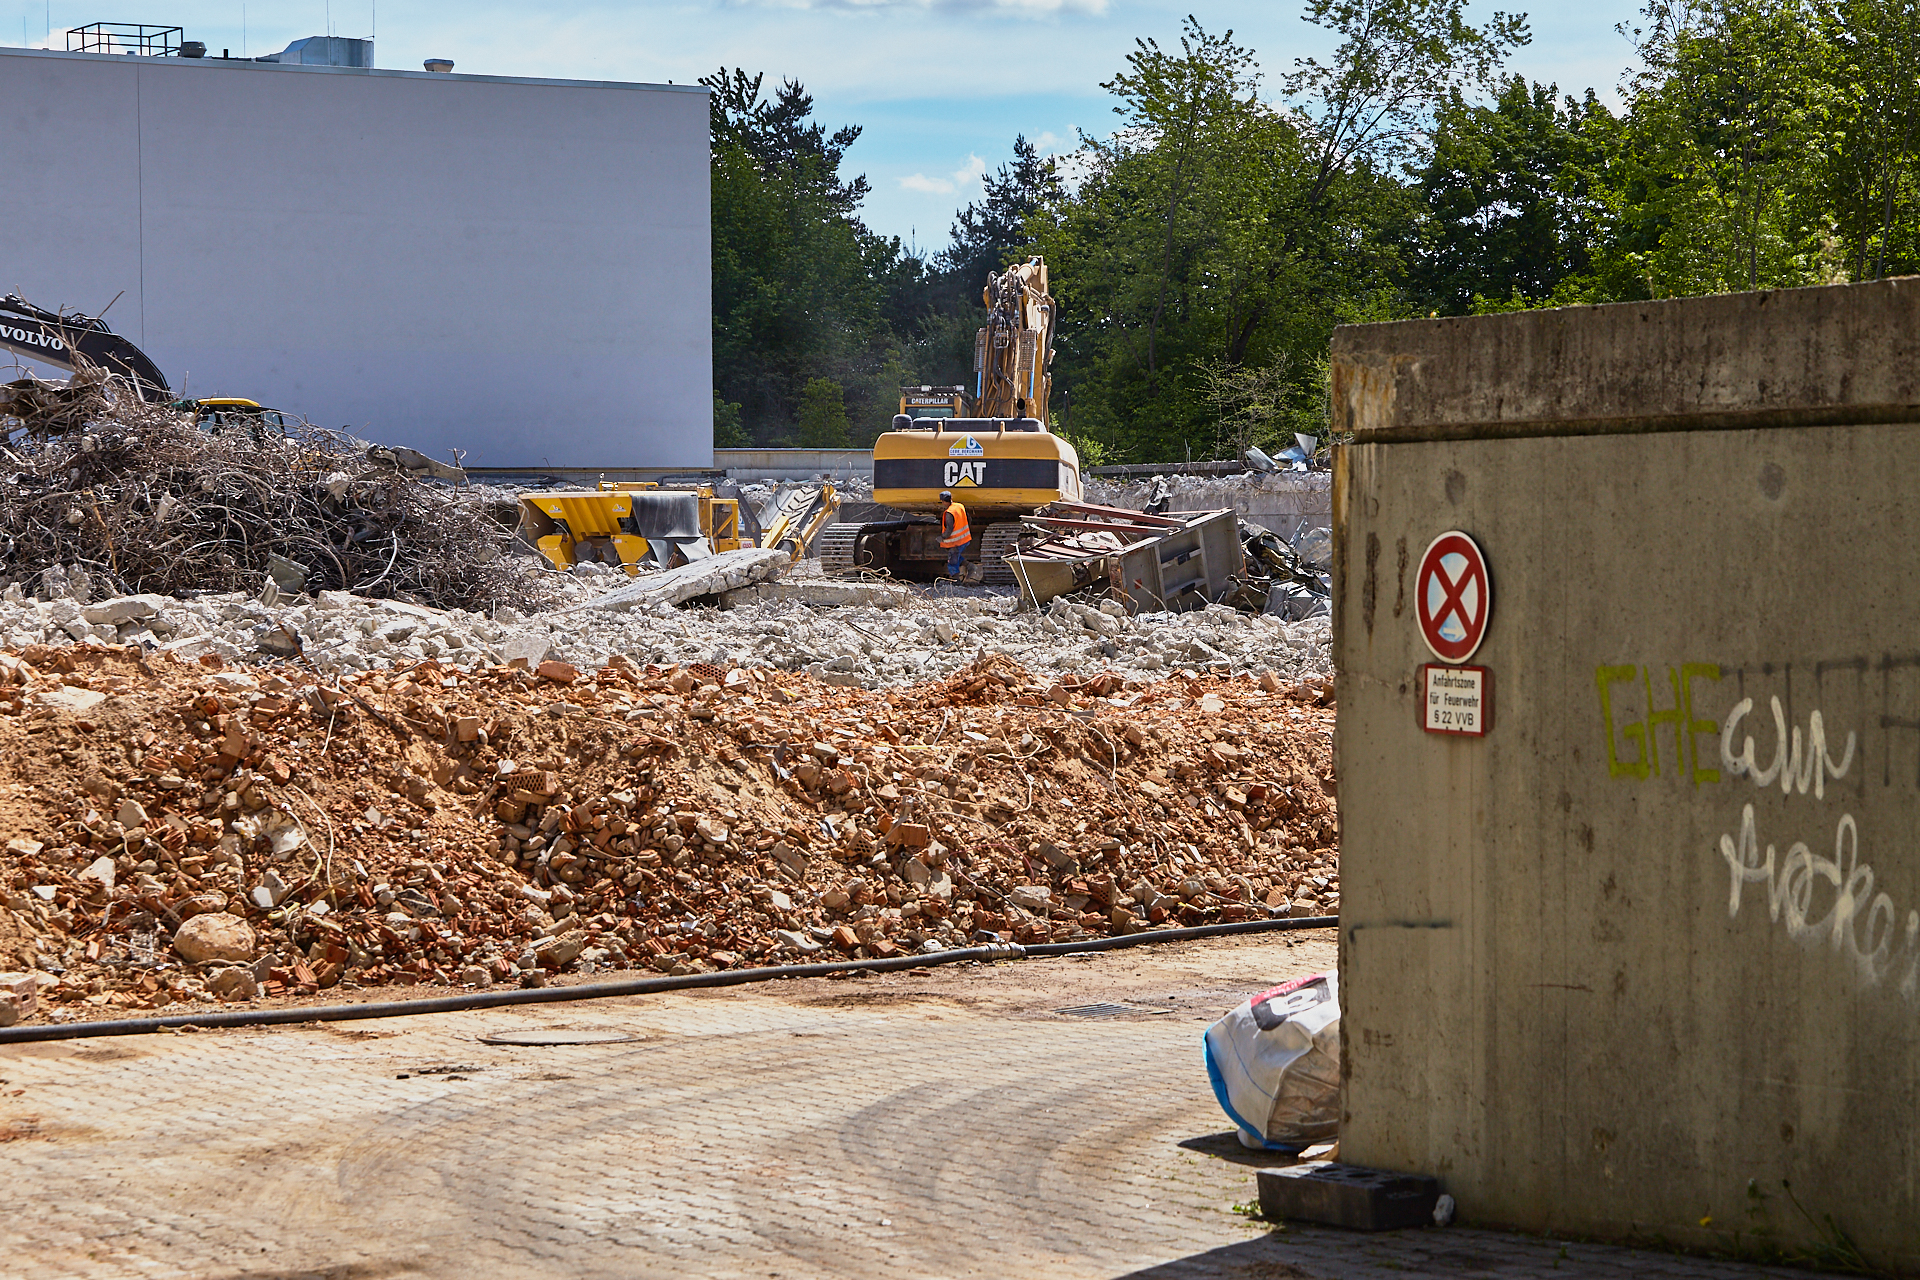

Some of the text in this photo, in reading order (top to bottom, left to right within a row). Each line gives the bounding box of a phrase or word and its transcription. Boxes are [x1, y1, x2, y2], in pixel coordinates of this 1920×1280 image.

[0, 324, 64, 351] VOLVO
[944, 461, 986, 487] CAT
[1432, 674, 1475, 689] Anfahrtszone
[1430, 692, 1479, 708] für Feuerwehr
[1434, 710, 1474, 726] § 22 VVB
